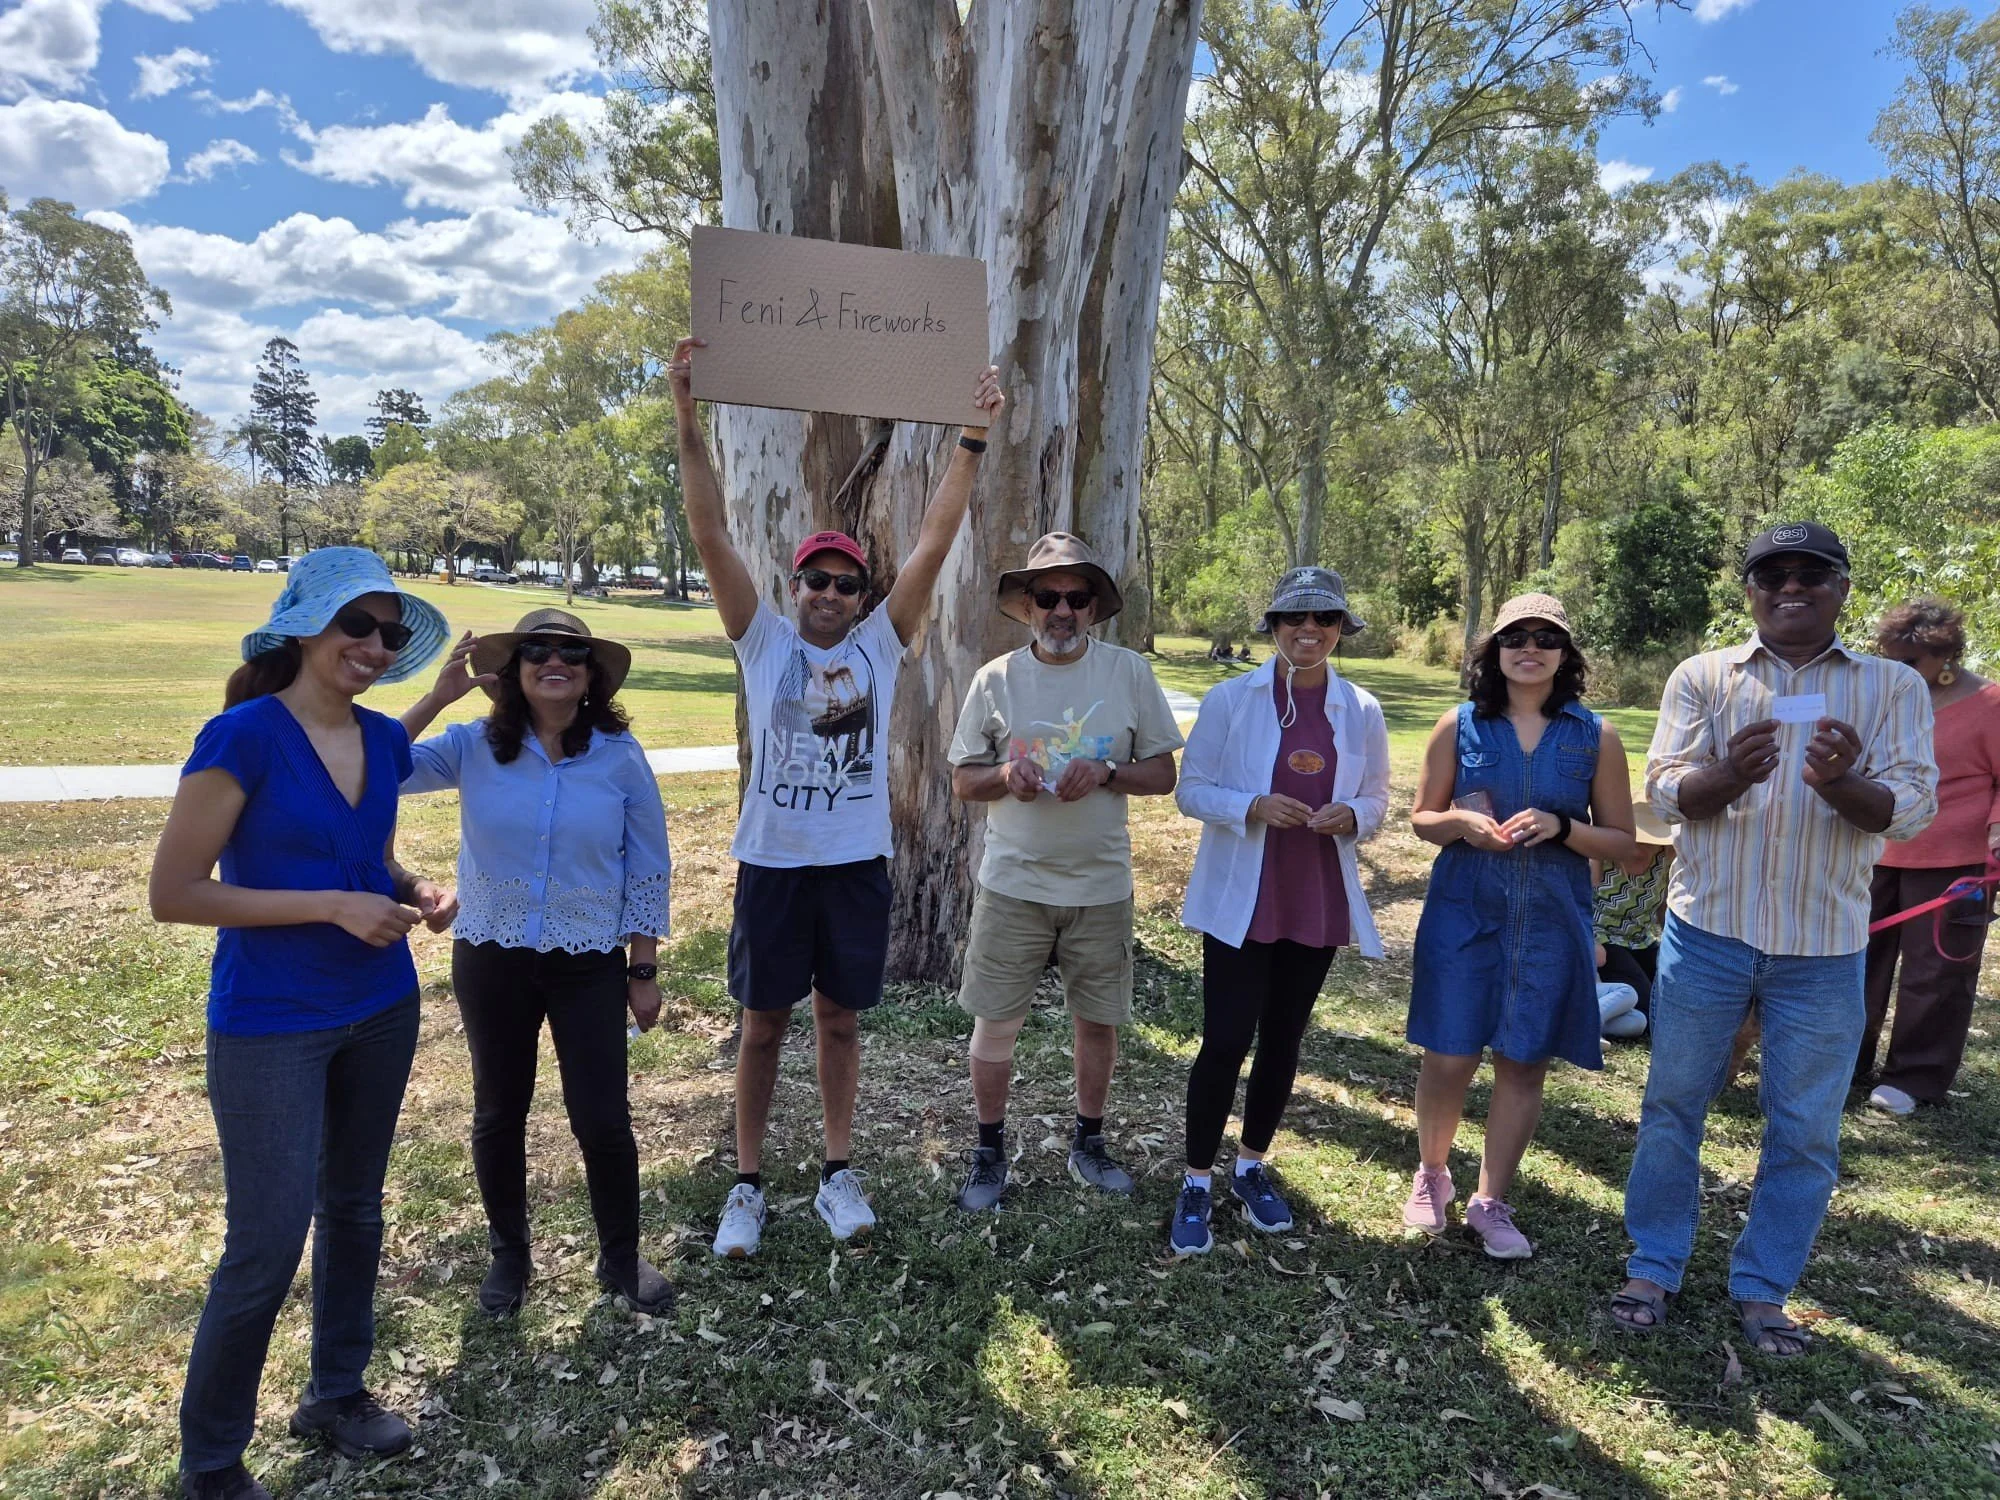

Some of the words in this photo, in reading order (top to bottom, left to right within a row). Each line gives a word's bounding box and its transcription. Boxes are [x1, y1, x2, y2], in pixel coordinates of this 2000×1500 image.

[719, 279, 784, 324] Feni
[795, 287, 829, 330] &
[839, 292, 946, 333] Fireworks
[770, 729, 850, 762] NEW
[769, 756, 855, 788] YORK
[773, 783, 843, 811] CITY
